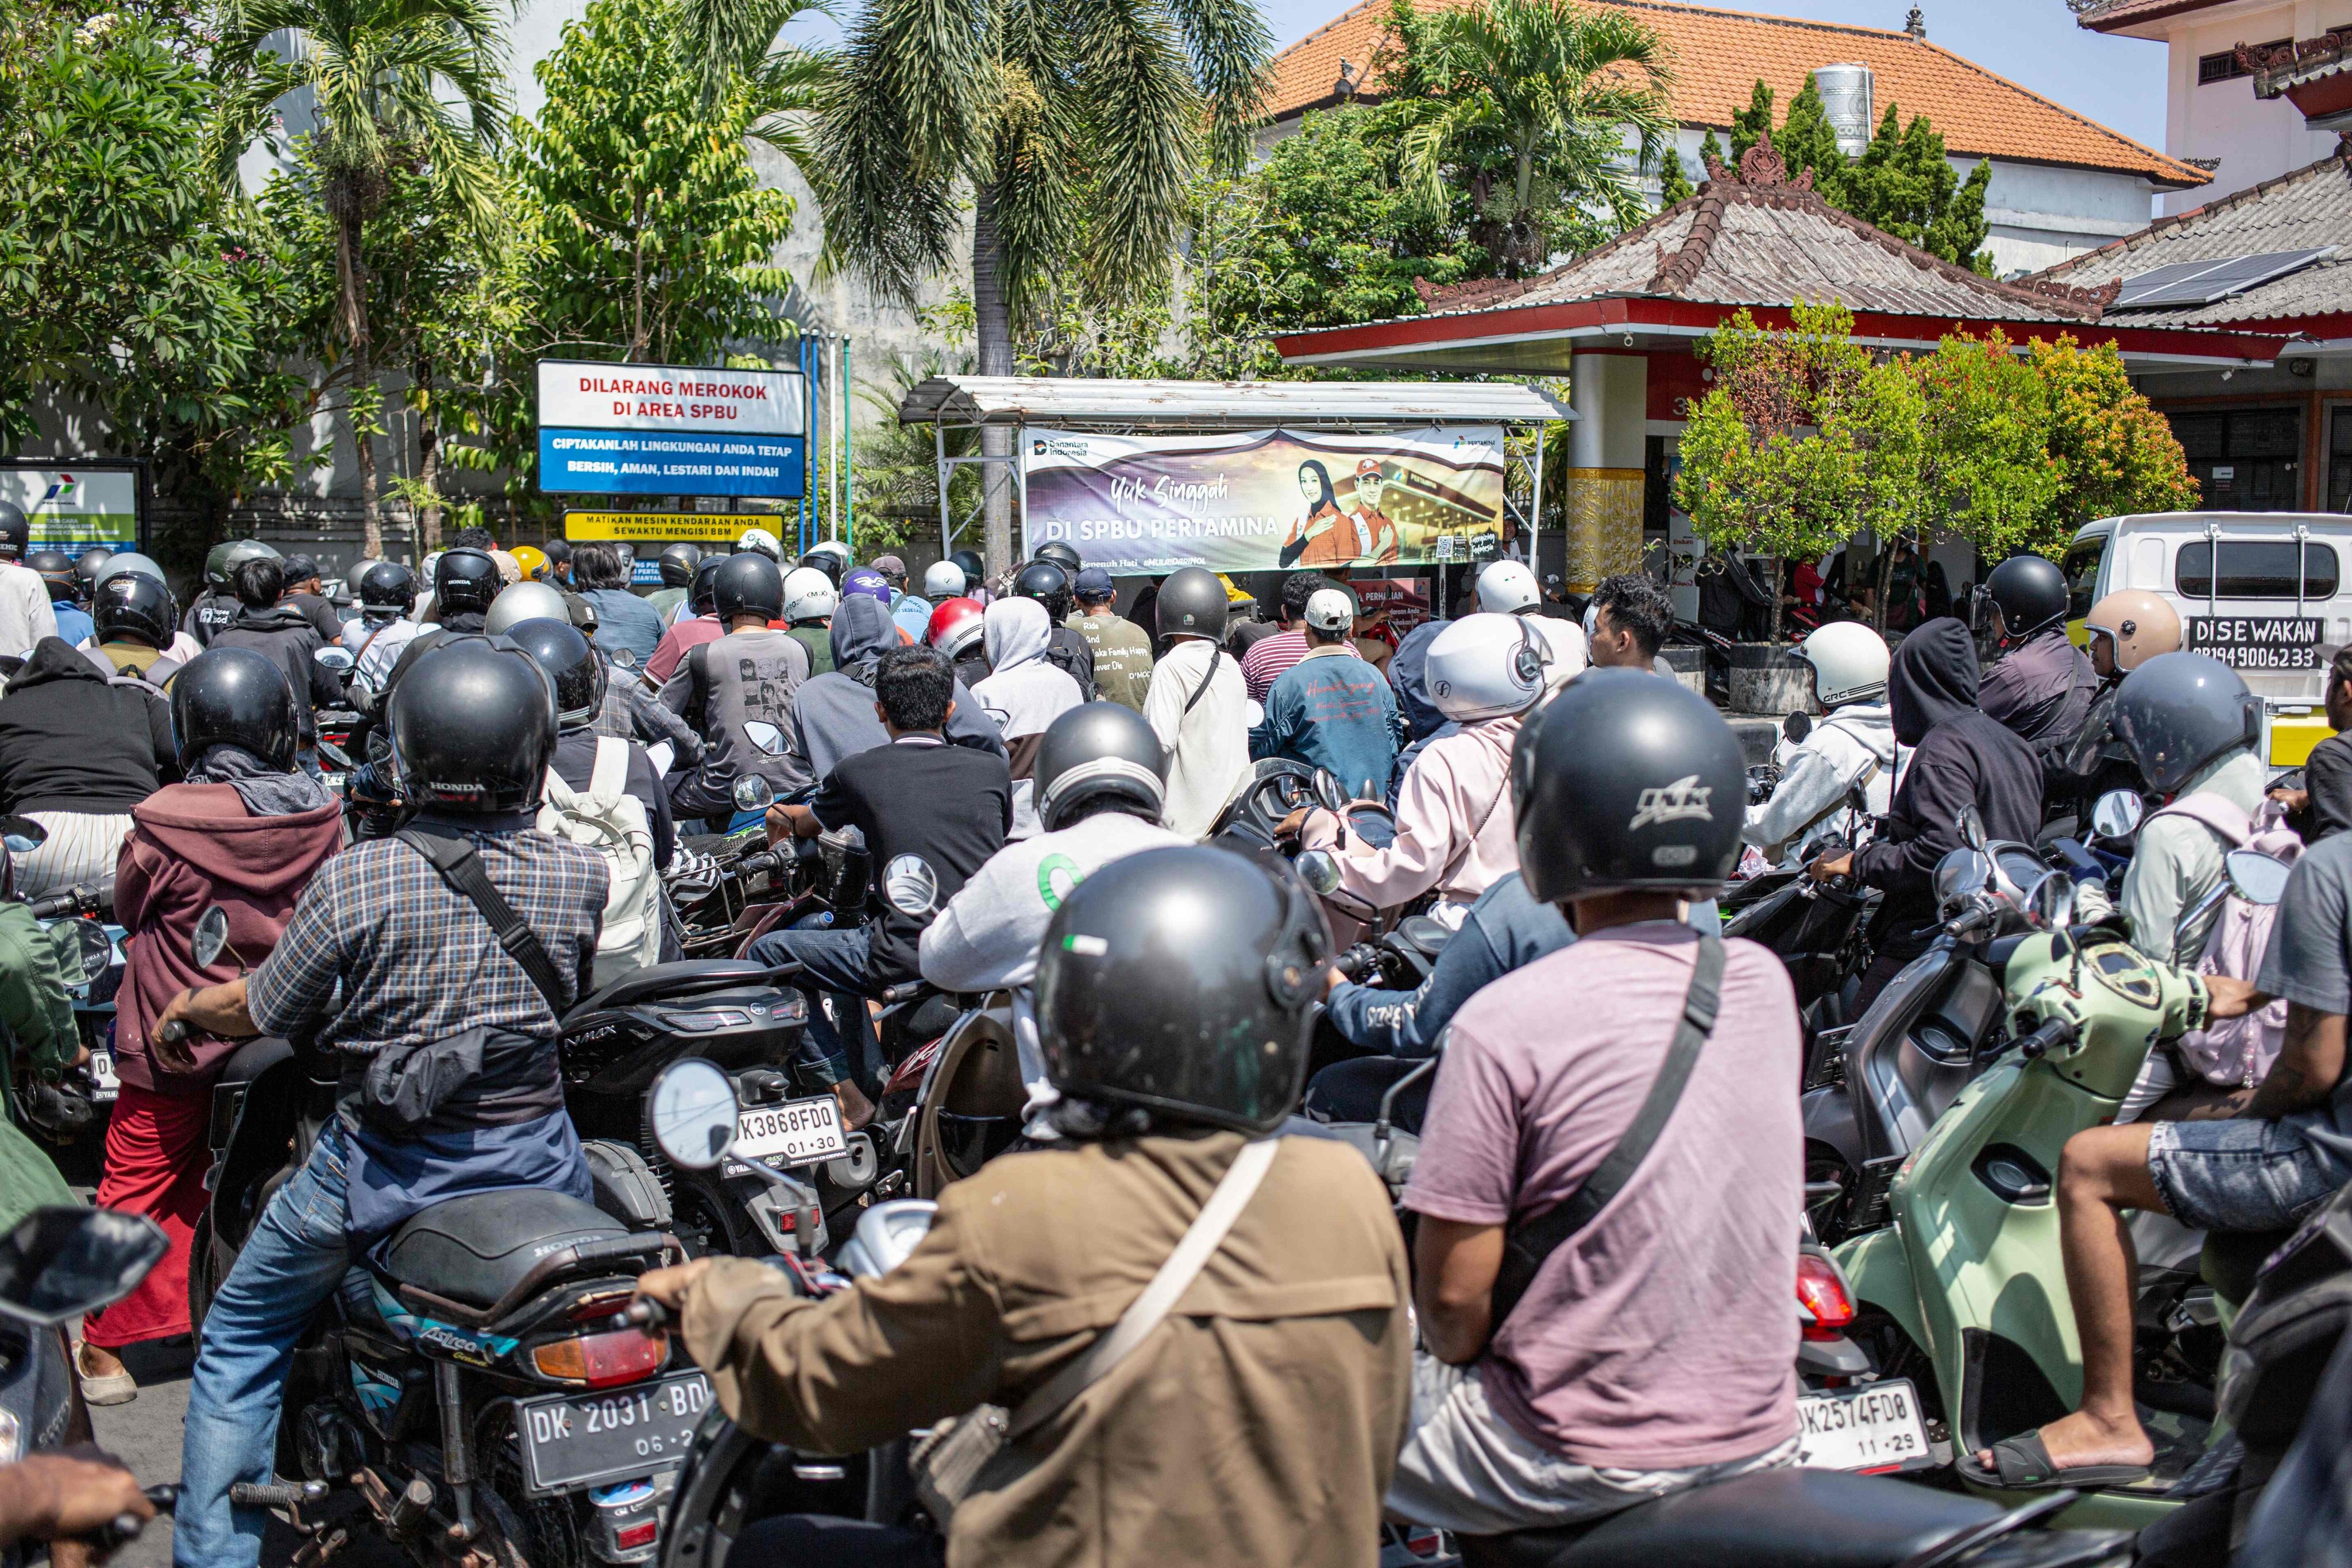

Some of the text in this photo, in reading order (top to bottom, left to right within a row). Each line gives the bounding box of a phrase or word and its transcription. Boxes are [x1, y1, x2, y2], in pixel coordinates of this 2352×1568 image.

[580, 378, 767, 400] DILARANG MEROKOK
[613, 401, 738, 420] DI AREA SPBU
[552, 438, 792, 457] CIPTAKANLAH LINGKUNGAN ANDA TETAP
[1049, 440, 1088, 448] Danantara
[1050, 448, 1087, 456] Indonesia
[567, 460, 779, 477] BERSIH, AMAN, LESTARI DAN INDAH
[1111, 473, 1229, 514] Yuk Singgah
[586, 516, 631, 524] MATIKAN
[635, 517, 667, 525] MESIN
[670, 517, 731, 526] KENDARAAN
[614, 527, 731, 536] SEWAKTU MENGISI BBM
[1046, 517, 1279, 541] DI SPBU PERTAMINA
[1119, 558, 1138, 567] Hati
[1365, 592, 1404, 601] PERHAIAN
[1083, 622, 1099, 631] Ride
[1092, 646, 1148, 658] ake Family Happy
[1111, 661, 1123, 670] Die
[1823, 690, 1847, 702] GRC
[430, 782, 486, 791] HONDA
[736, 1106, 833, 1141] K3868FDQ
[790, 1156, 819, 1165] SEMAKIN
[377, 1369, 399, 1388] HONDA
[533, 1407, 570, 1443] DK
[585, 1392, 650, 1434] 2031
